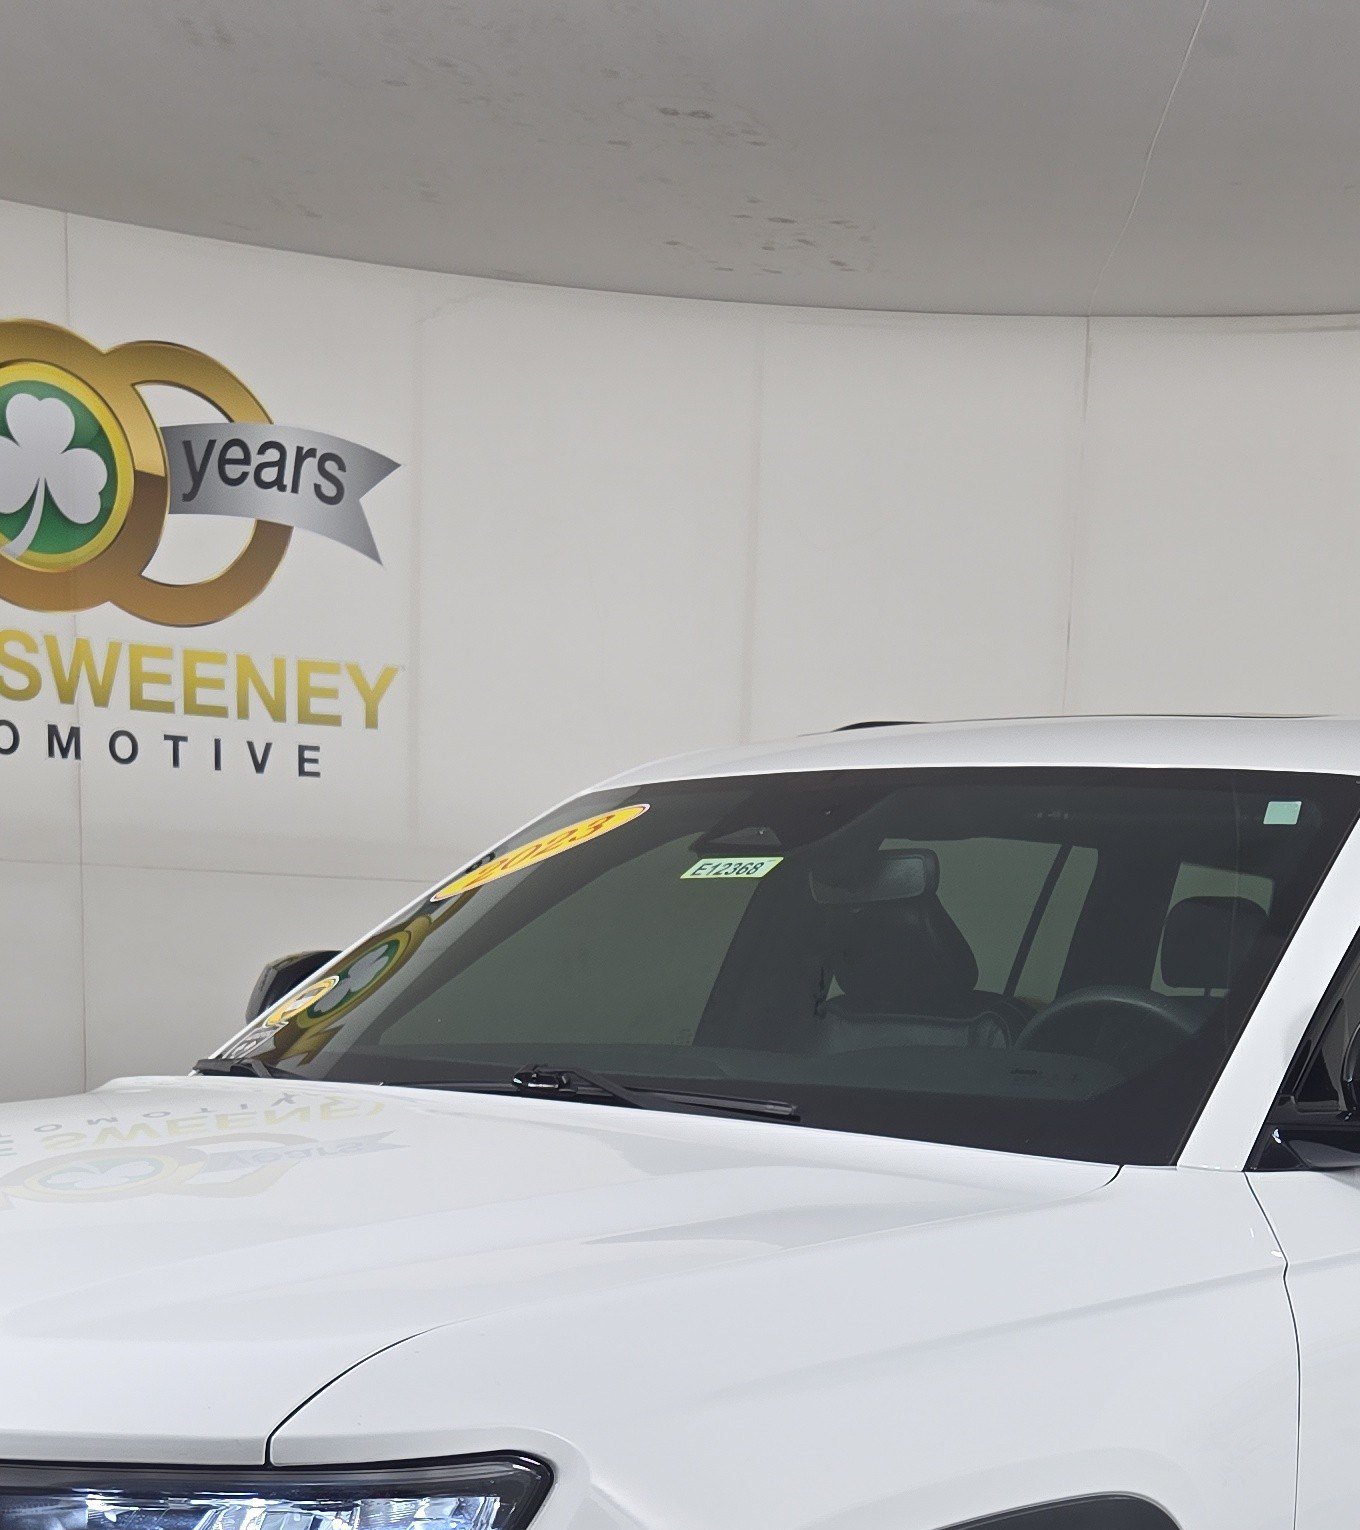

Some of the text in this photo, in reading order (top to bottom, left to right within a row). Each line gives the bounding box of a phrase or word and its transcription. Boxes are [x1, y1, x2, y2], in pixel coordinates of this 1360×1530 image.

[181, 438, 347, 505] years
[462, 814, 616, 889] 2023
[690, 862, 765, 876] E12368
